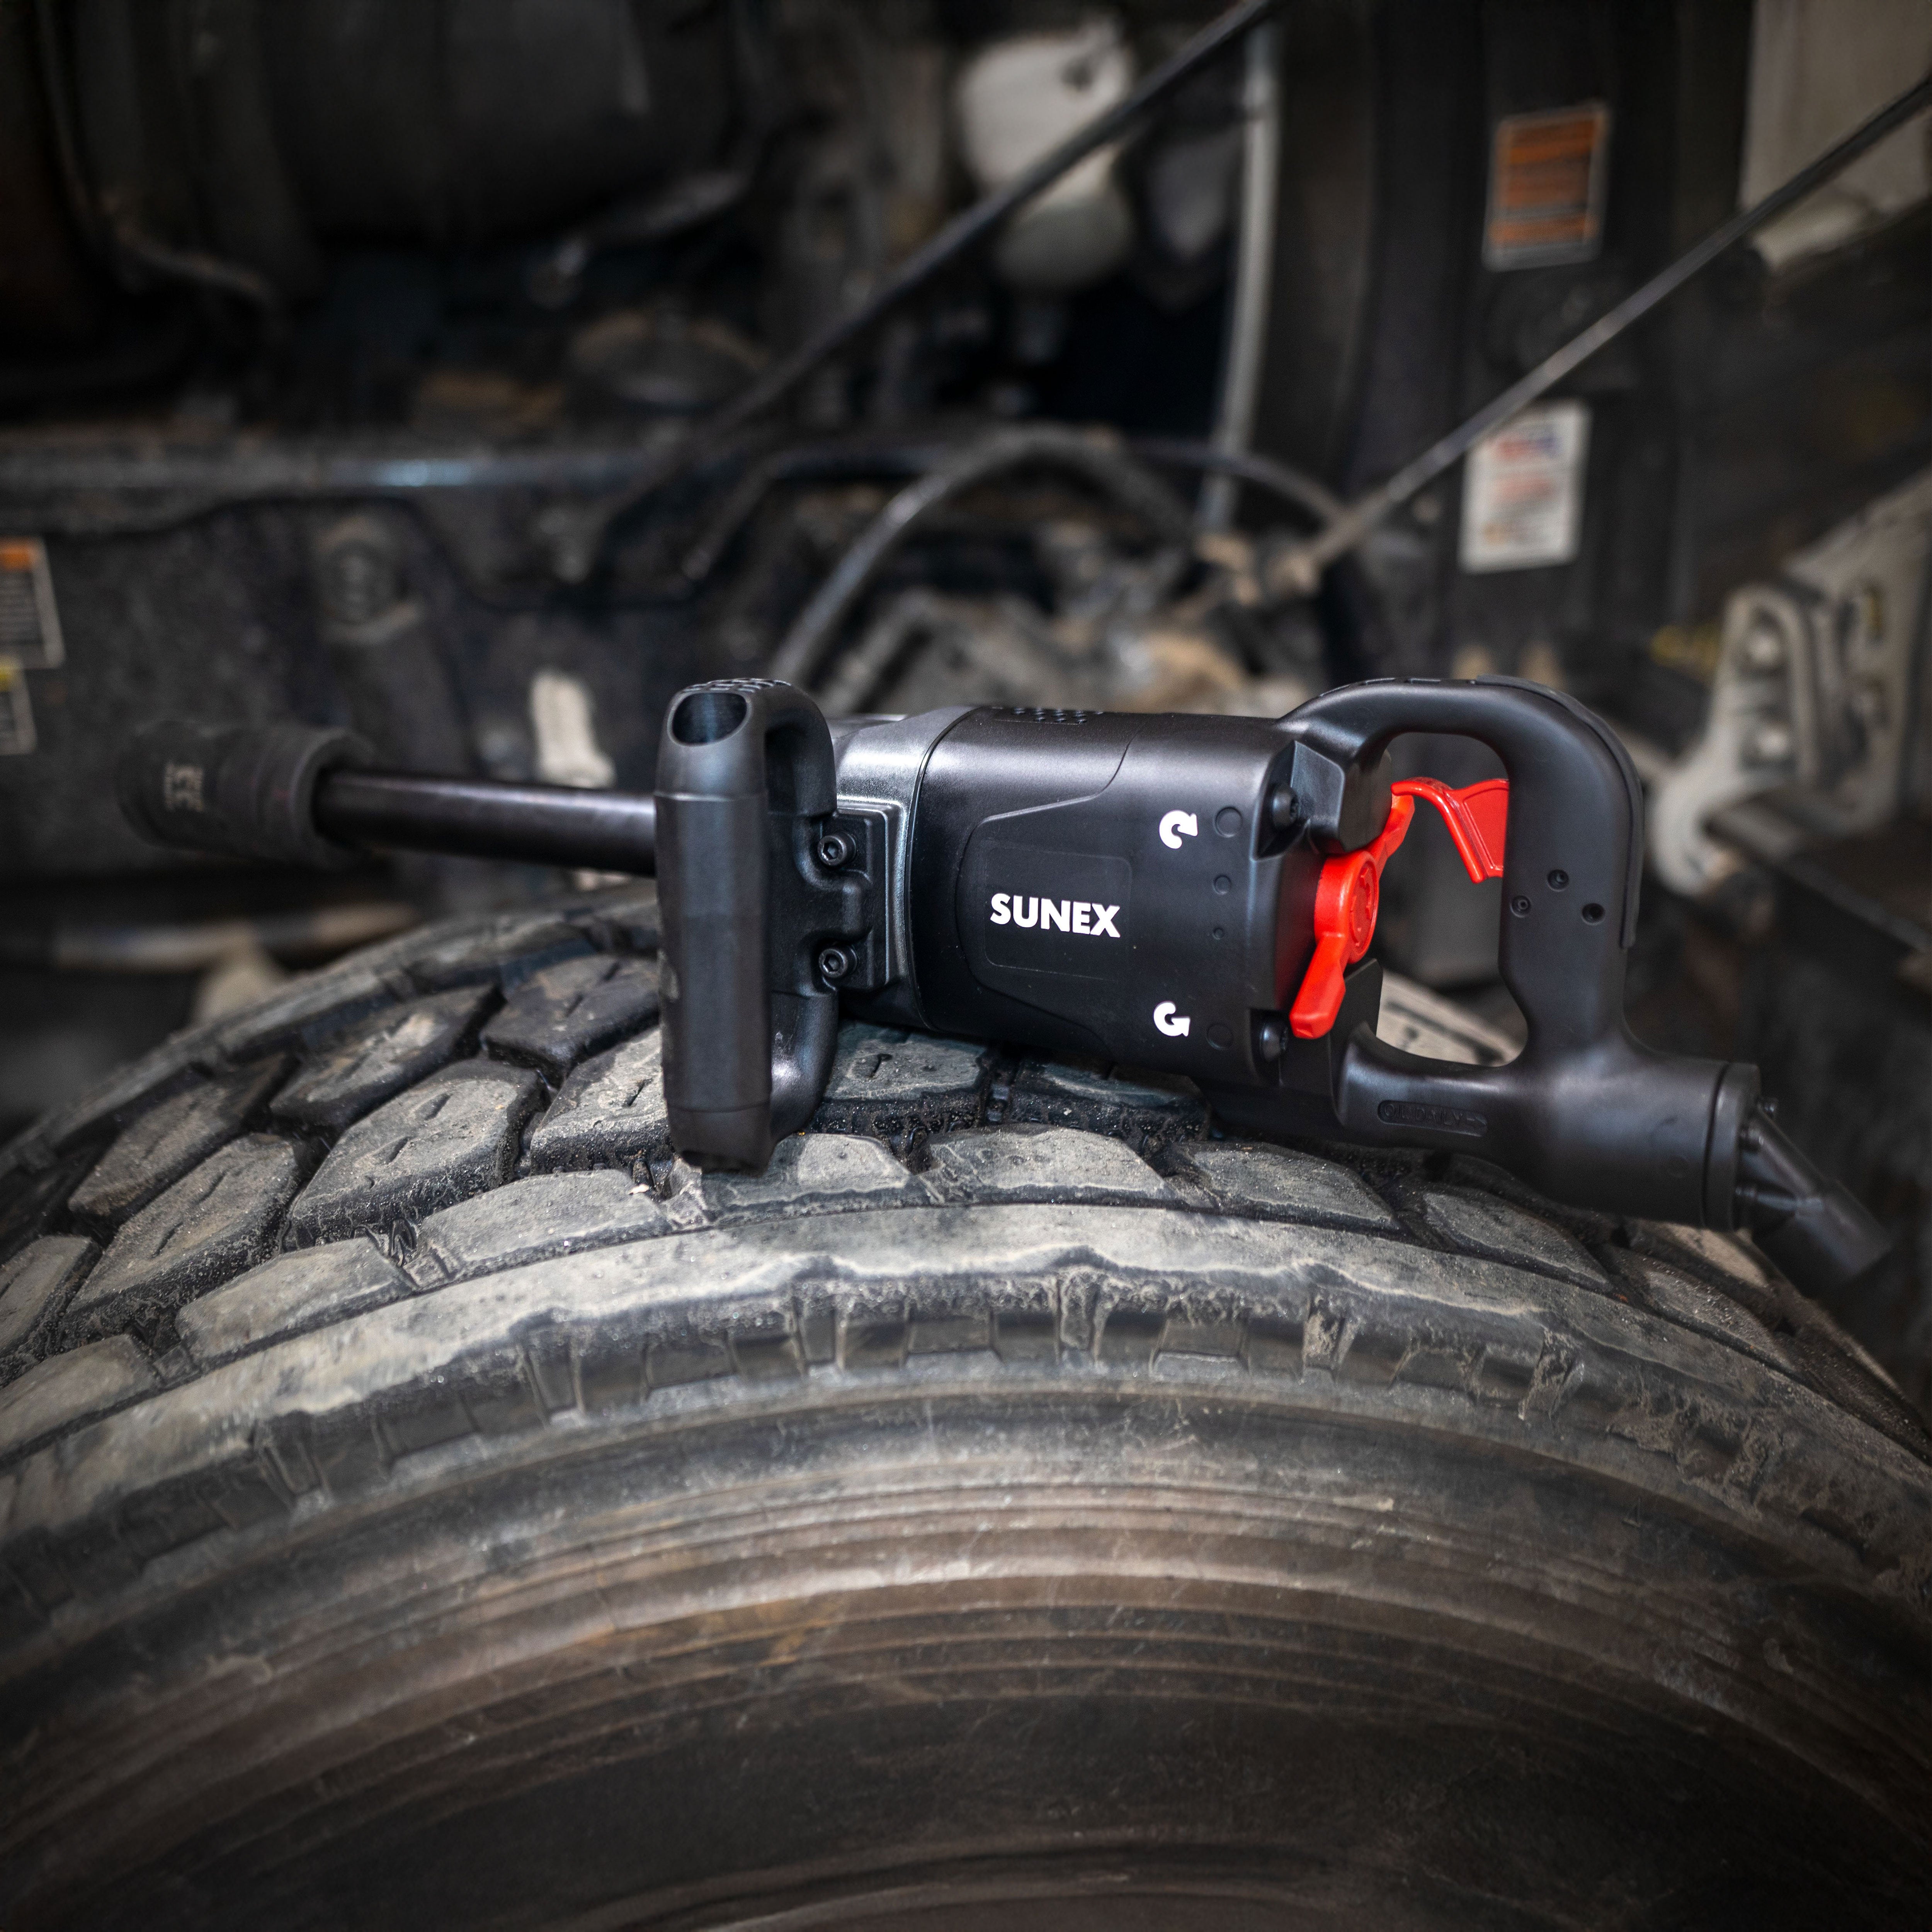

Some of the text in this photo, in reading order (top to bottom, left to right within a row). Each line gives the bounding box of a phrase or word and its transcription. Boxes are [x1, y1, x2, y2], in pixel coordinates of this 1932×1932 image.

[990, 893, 1121, 938] SUNEX
[1384, 1103, 1464, 1126] OIL DAILY
